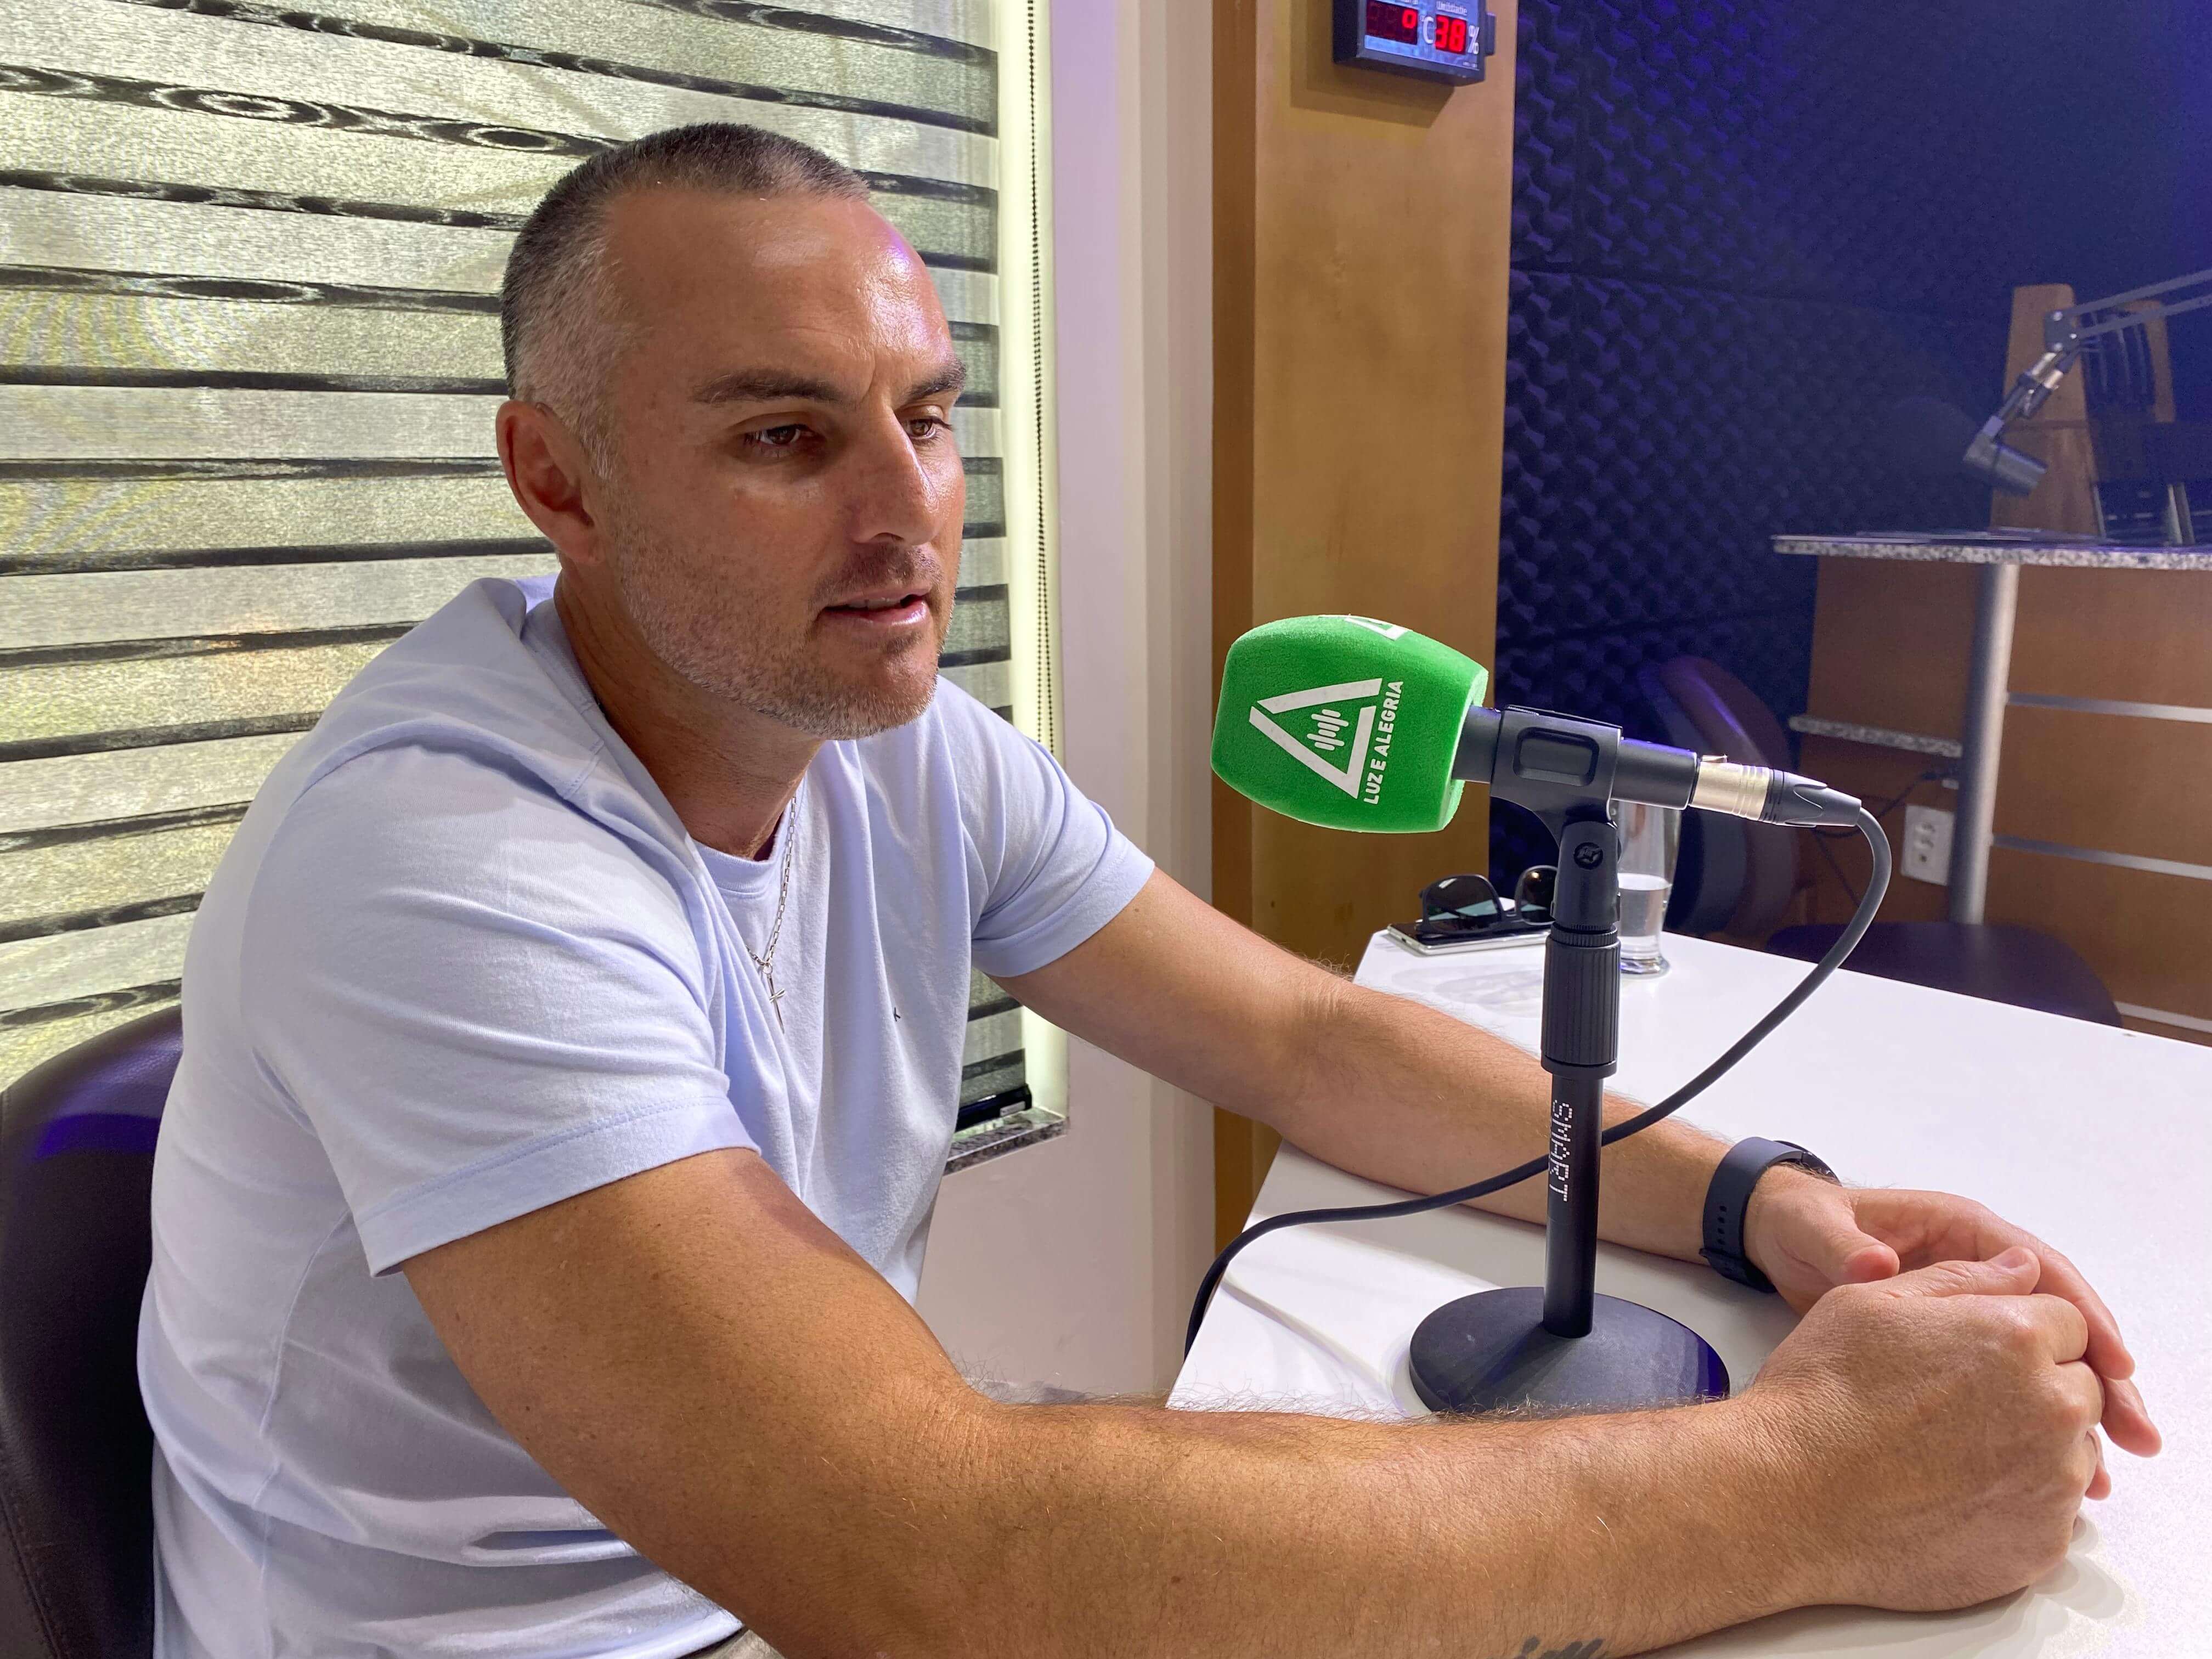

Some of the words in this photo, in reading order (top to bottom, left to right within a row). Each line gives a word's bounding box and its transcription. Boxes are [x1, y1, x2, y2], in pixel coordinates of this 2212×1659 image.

[1374, 681, 1404, 758] ALEGRIA
[1363, 772, 1384, 805] LUZ
[1370, 758, 1387, 771] E
[1549, 1099, 1573, 1202] SMART
